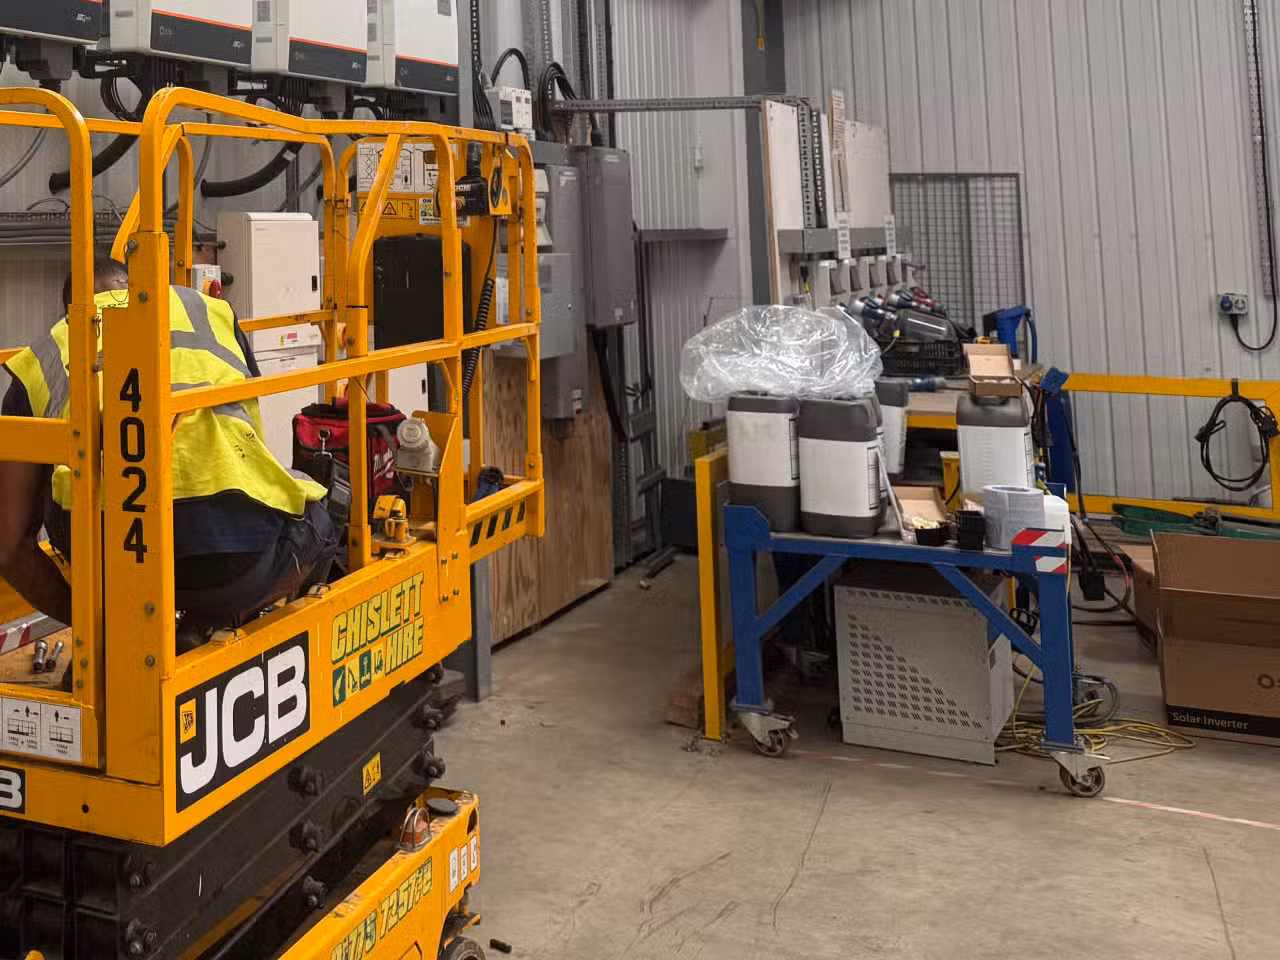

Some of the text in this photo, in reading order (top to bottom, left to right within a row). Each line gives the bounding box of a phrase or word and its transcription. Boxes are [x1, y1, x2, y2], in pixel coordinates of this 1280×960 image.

[120, 367, 148, 564] 4024
[331, 571, 424, 665] CHISLETT
[384, 615, 424, 676] HIRE
[180, 644, 308, 794] JCB
[1172, 712, 1249, 730] Solar Inverter
